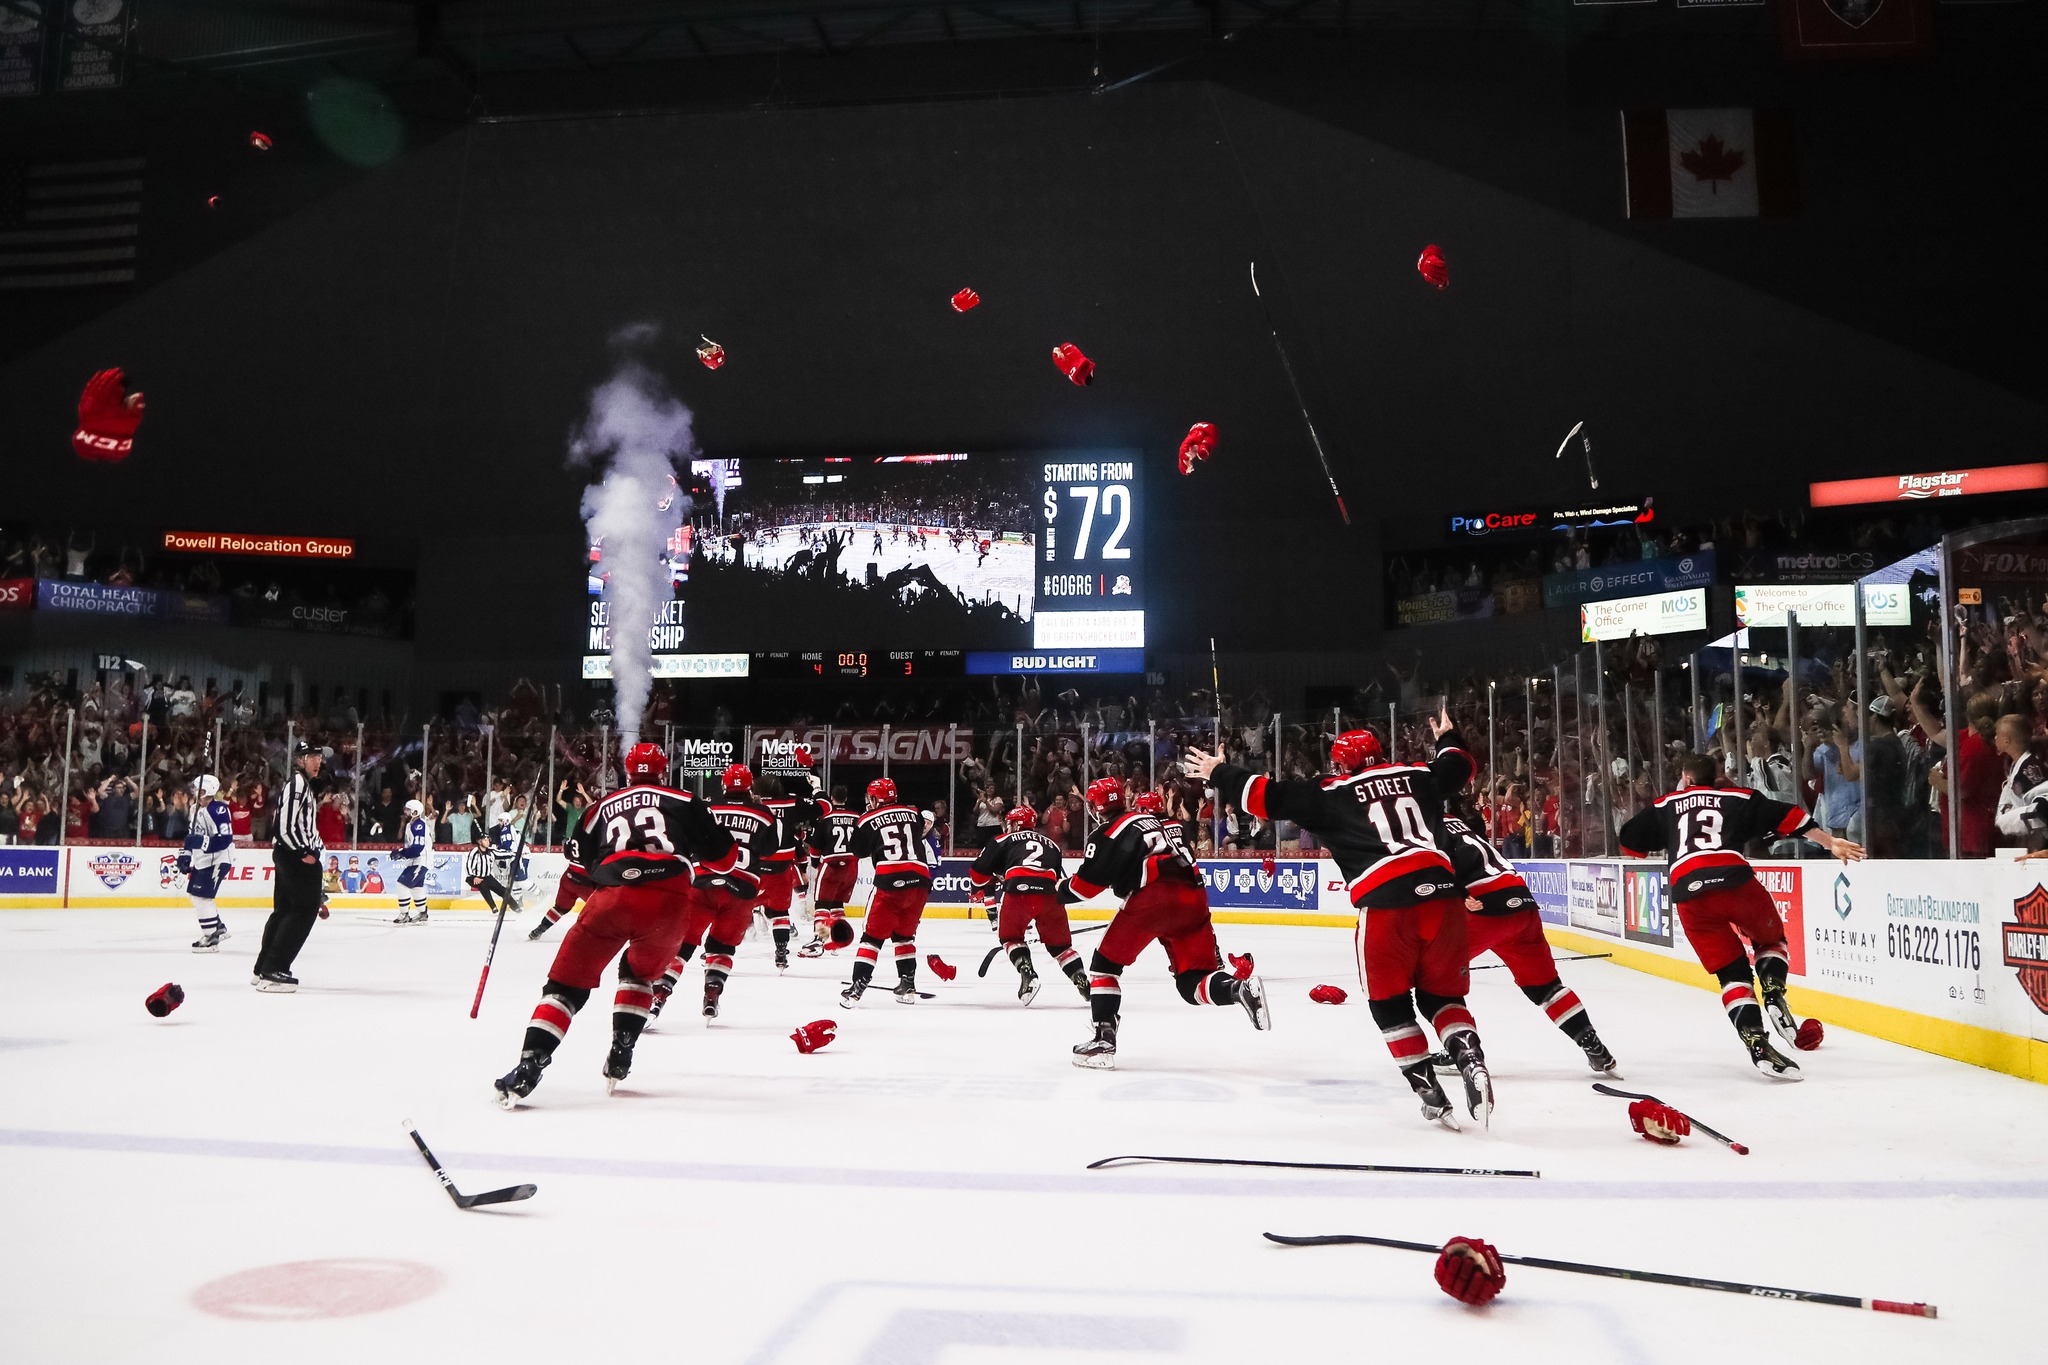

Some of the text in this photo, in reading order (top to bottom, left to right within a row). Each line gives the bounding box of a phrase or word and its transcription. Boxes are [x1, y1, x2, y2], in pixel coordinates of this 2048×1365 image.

[1044, 462, 1132, 482] STARTING FROM
[1898, 472, 1966, 489] Flagstar
[1938, 487, 1962, 497] Bank
[1611, 505, 1638, 514] Specialists
[1043, 486, 1057, 524] $
[1069, 485, 1131, 560] 72
[1451, 513, 1536, 532] ProCare
[164, 534, 353, 556] Powell Relocation Group
[1777, 552, 1875, 569] metroPCS
[1982, 553, 2030, 573] FOX
[51, 583, 157, 602] TOTAL HEALTH
[1548, 571, 1654, 597] LAKER EFFECT
[1754, 589, 1808, 597] Welcome to
[50, 596, 156, 615] CHIROPRACTIC
[292, 605, 348, 623] custer
[1594, 601, 1648, 615] The Corner
[1756, 600, 1846, 612] The Corner Office
[1594, 615, 1624, 627] Office
[98, 655, 121, 670] 112
[801, 653, 823, 661] HOME
[890, 651, 914, 660] GUEST
[1012, 656, 1097, 669] BUD LIGHT
[814, 664, 822, 675] 4
[861, 667, 867, 676] 3
[904, 662, 912, 675] 3
[684, 739, 734, 755] Metro
[750, 729, 974, 761] FASTSIGNS
[637, 763, 649, 773] 23
[684, 754, 722, 768] Health
[1364, 755, 1375, 767] 10
[683, 769, 704, 778] Sports
[783, 769, 811, 777] Medicine
[733, 778, 742, 787] 15
[1354, 776, 1413, 803] STREET
[1675, 795, 1722, 815] HRONEK
[606, 806, 675, 854] 23
[1368, 796, 1438, 855] 10
[1676, 809, 1724, 859] 13
[880, 823, 918, 861] 51
[1011, 832, 1054, 849] HICKETTS
[1022, 840, 1044, 867] 2
[18, 866, 54, 877] BANK
[931, 874, 972, 892] etro
[1596, 879, 1611, 906] FOX
[1627, 876, 1659, 930] 123
[1814, 927, 1877, 949] GATEWAY
[2007, 931, 2048, 961] HARLEY-D
[1887, 922, 1981, 972] 616.222.1176
[1831, 950, 1878, 965] BELKNAP
[1820, 968, 1875, 986] APARTMENTS
[1750, 1287, 1799, 1301] CCM
